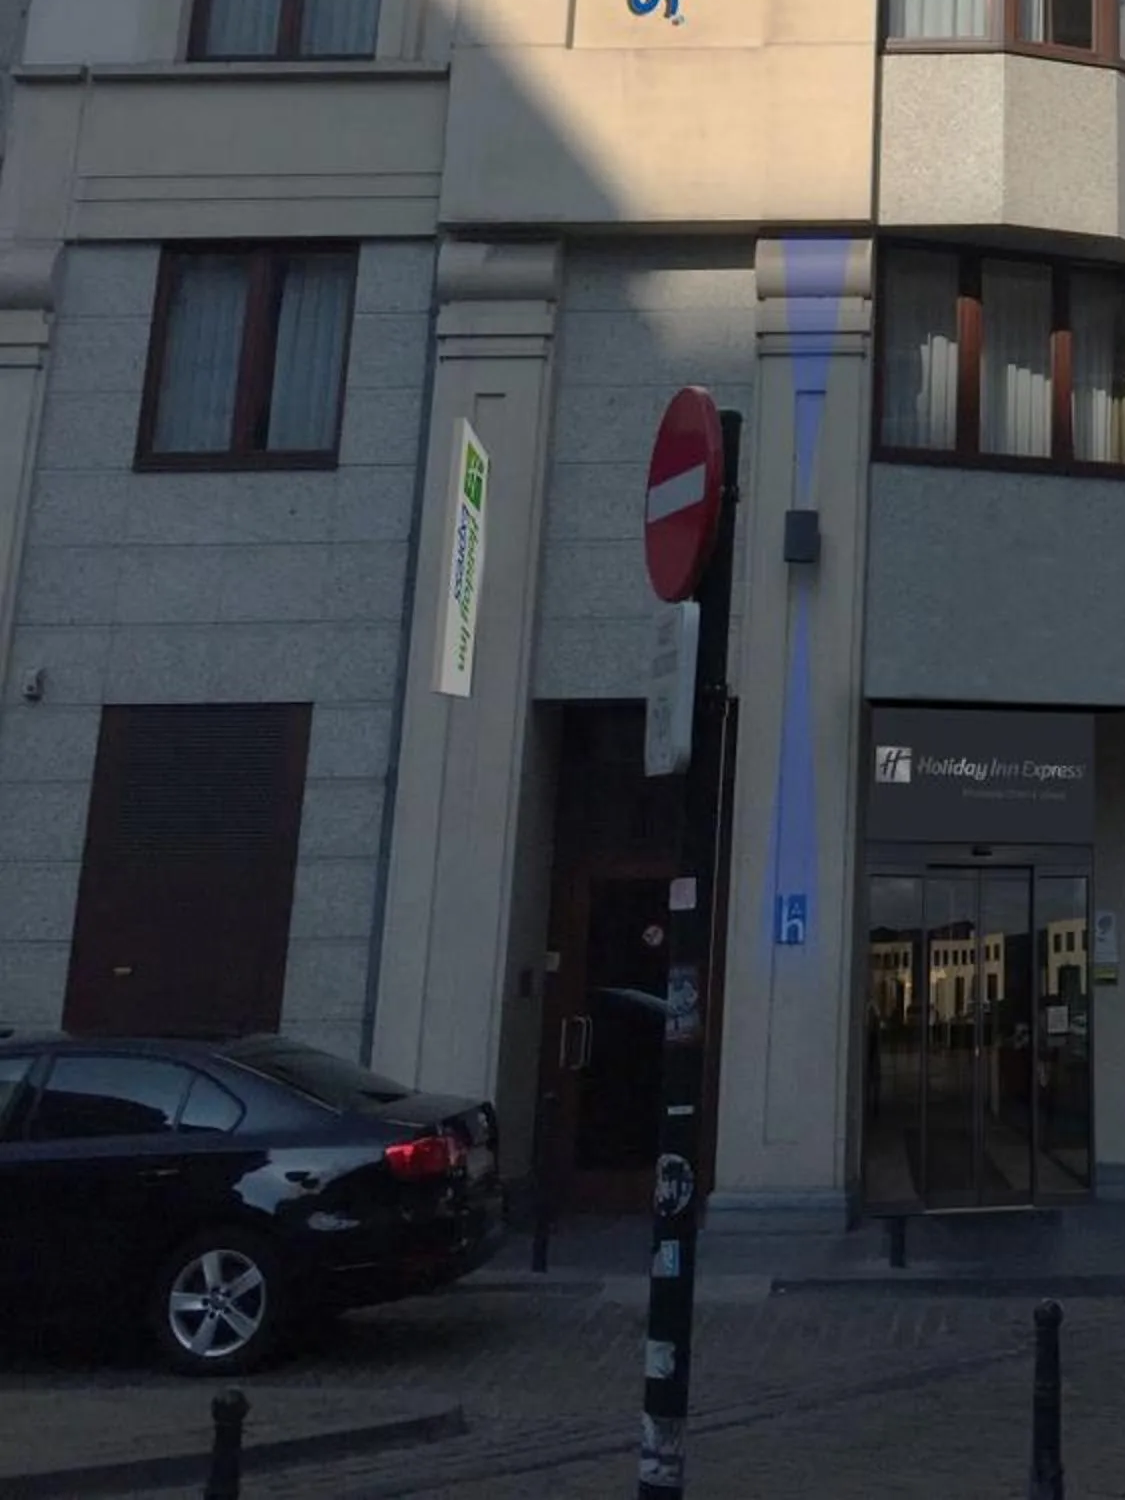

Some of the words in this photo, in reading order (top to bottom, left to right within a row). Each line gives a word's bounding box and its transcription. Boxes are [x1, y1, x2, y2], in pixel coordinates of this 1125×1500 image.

[917, 756, 988, 780] Holiday
[989, 757, 1020, 778] Inn
[1022, 760, 1085, 781] Express
